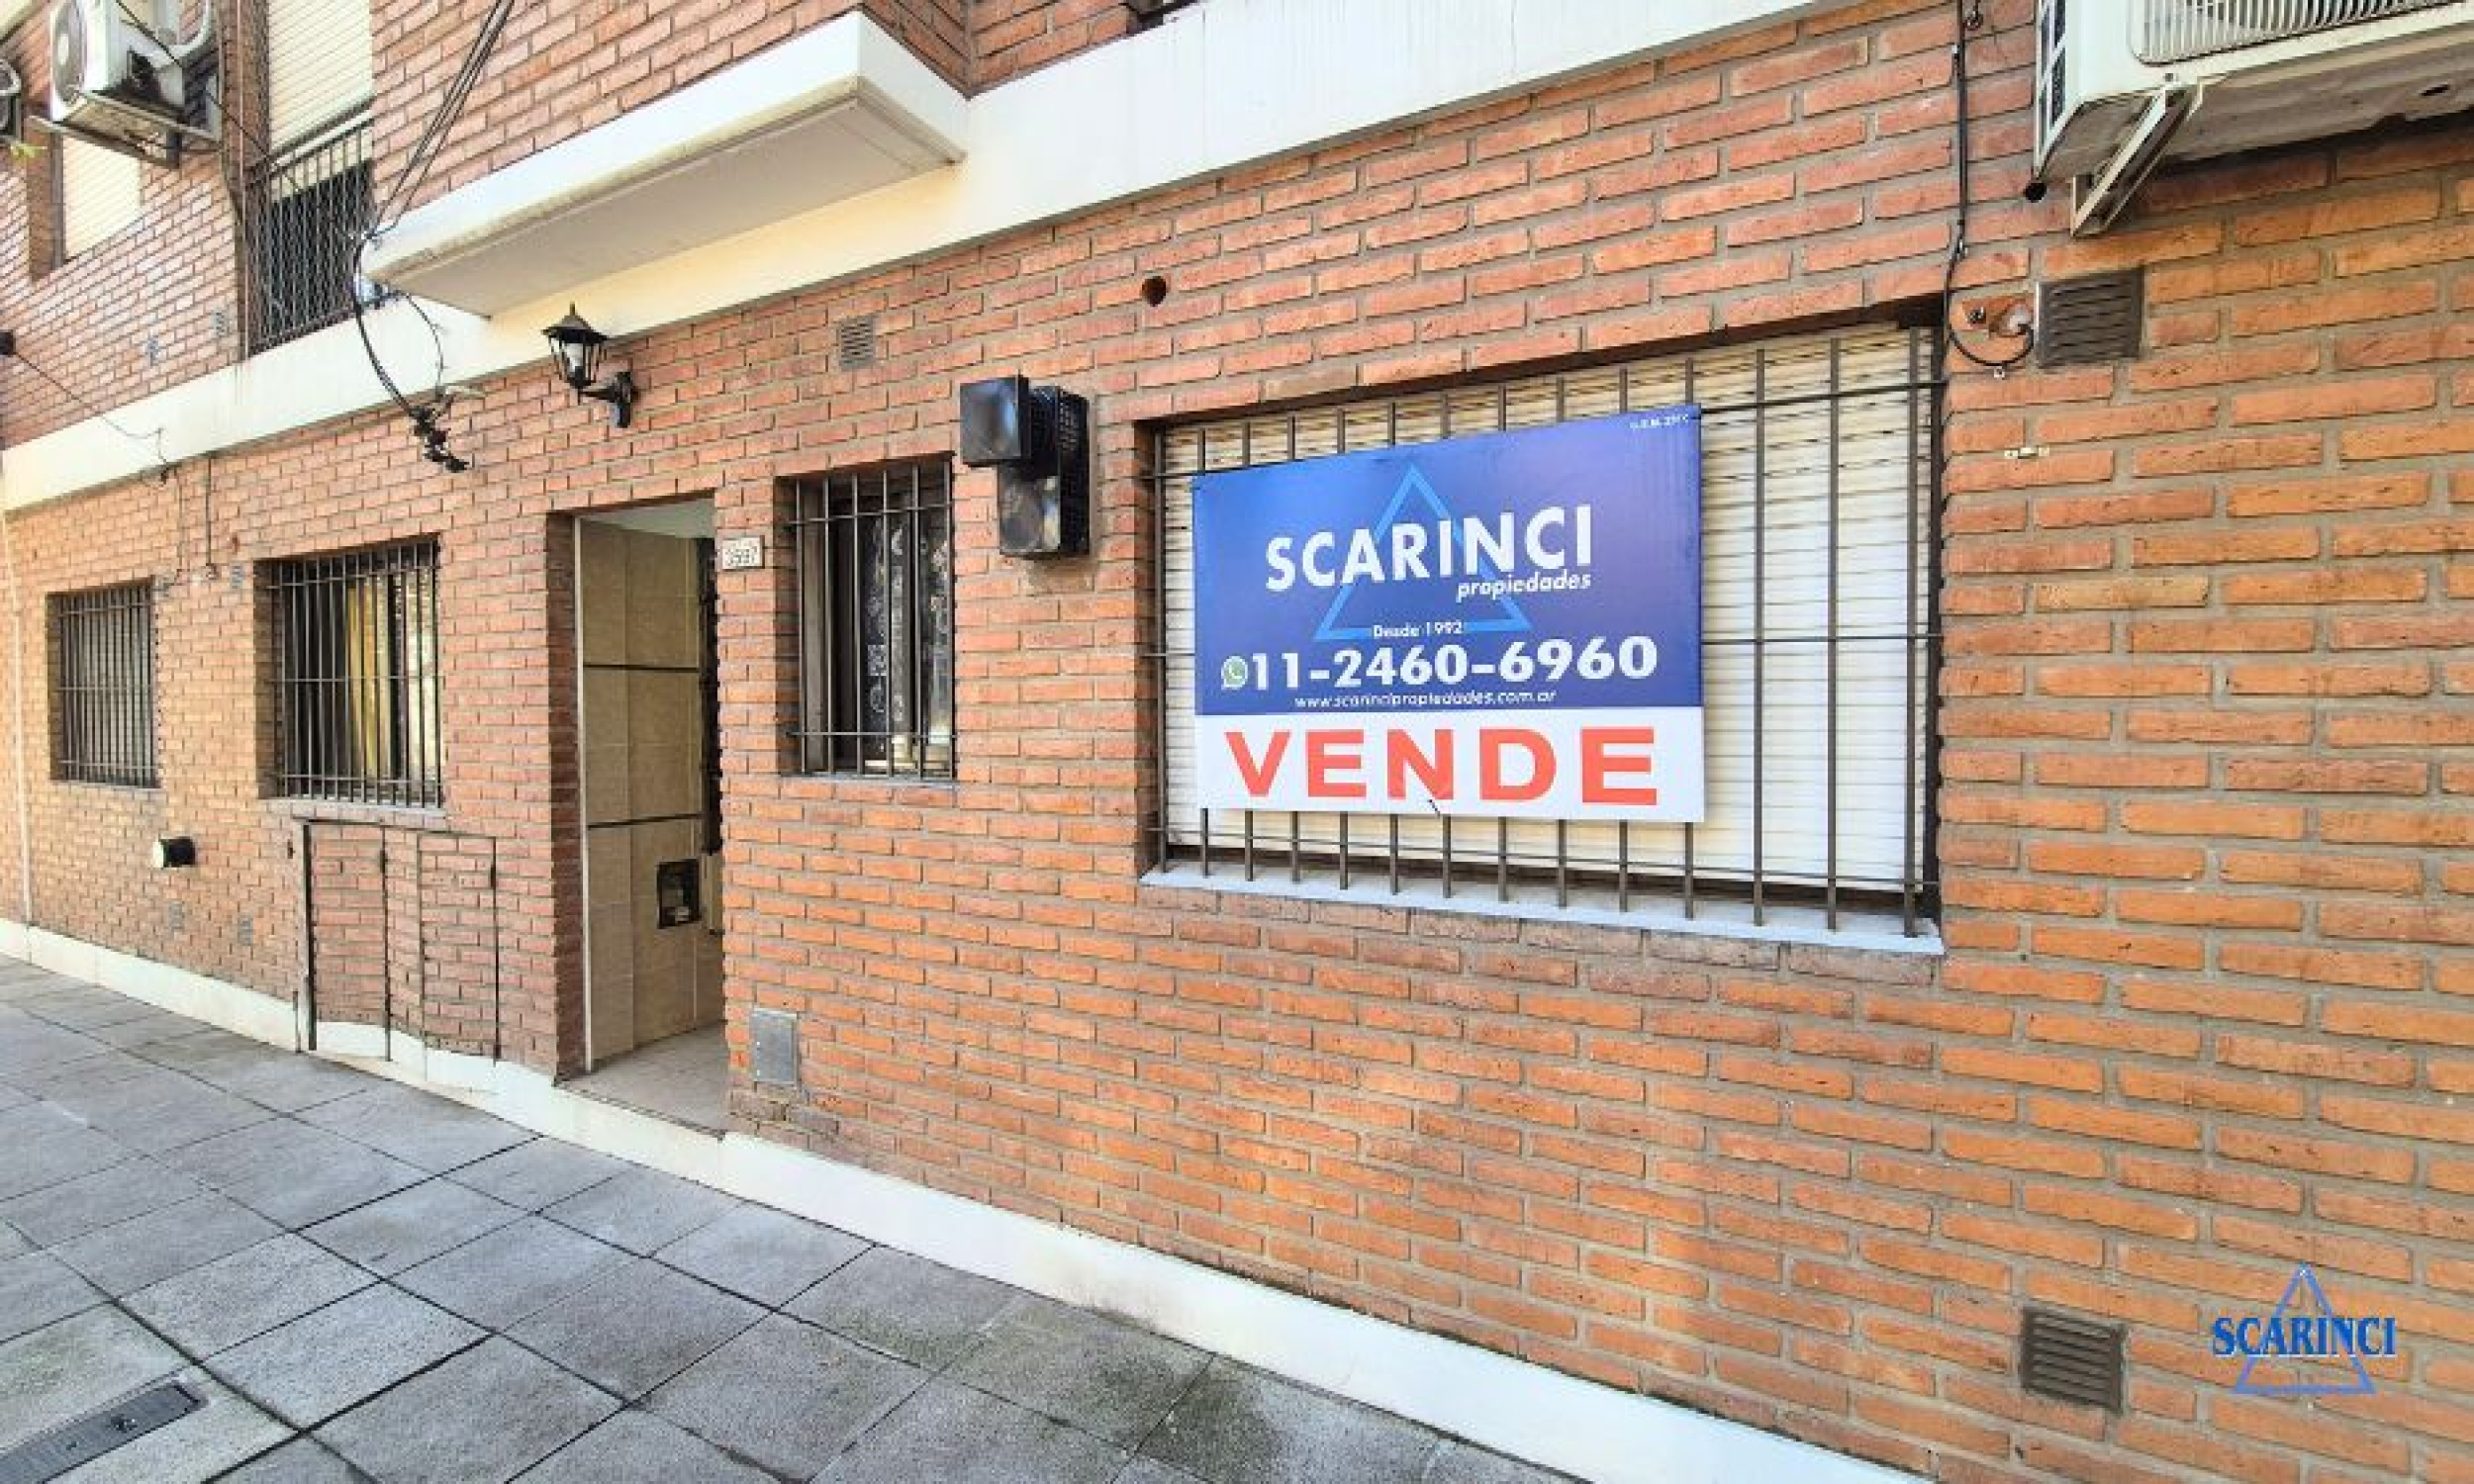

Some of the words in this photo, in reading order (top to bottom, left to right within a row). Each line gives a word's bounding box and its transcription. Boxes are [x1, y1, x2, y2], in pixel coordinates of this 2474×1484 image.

[1265, 504, 1591, 593] SCARINCI
[1456, 569, 1591, 603] propiedades
[1373, 623, 1420, 638] Desde
[1425, 618, 1464, 636] 1992
[1252, 636, 1659, 691] 11-2460-6960
[1294, 690, 1558, 708] www.scarincipropiedades.com.ar
[1223, 727, 1659, 806] VENDE
